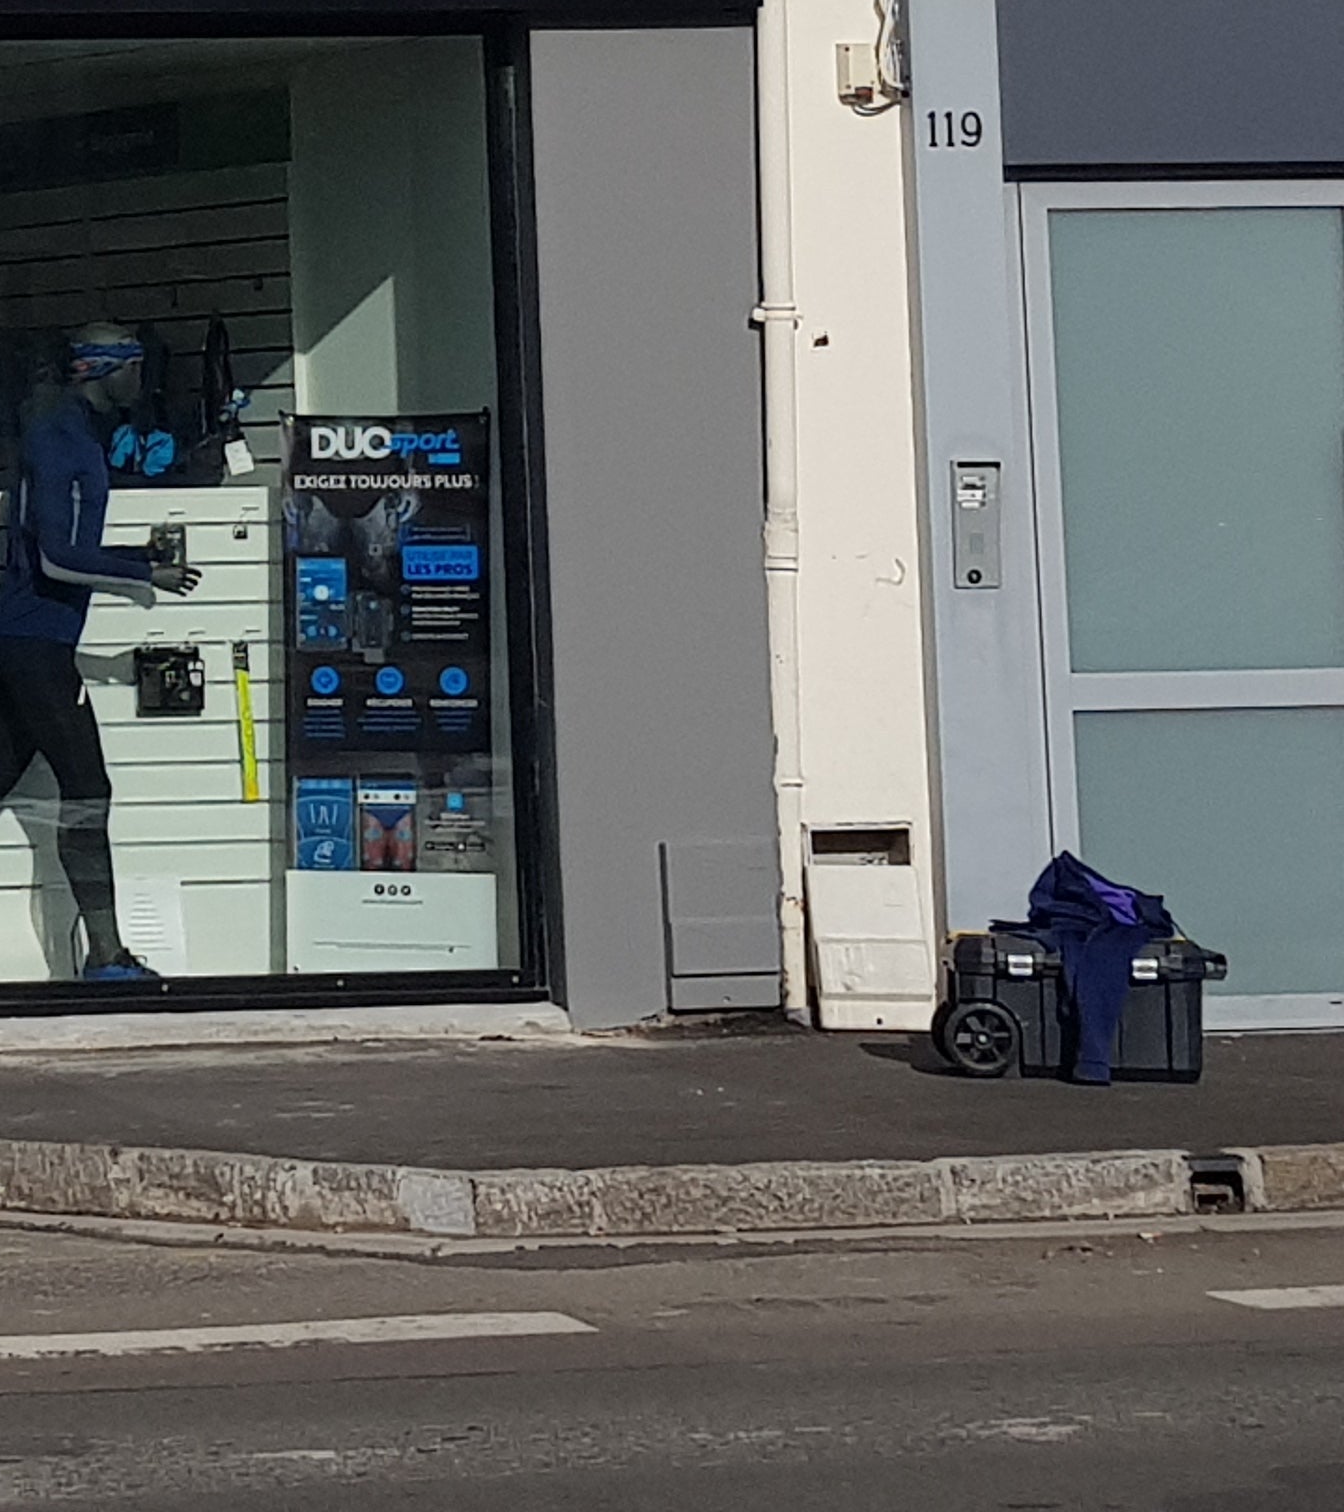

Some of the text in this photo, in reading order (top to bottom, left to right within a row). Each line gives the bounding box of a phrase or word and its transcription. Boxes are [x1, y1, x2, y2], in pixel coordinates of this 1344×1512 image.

[927, 111, 983, 148] 119
[350, 474, 432, 489] TOUJOURS
[435, 474, 472, 489] PLUS
[407, 563, 473, 575] LES PROS
